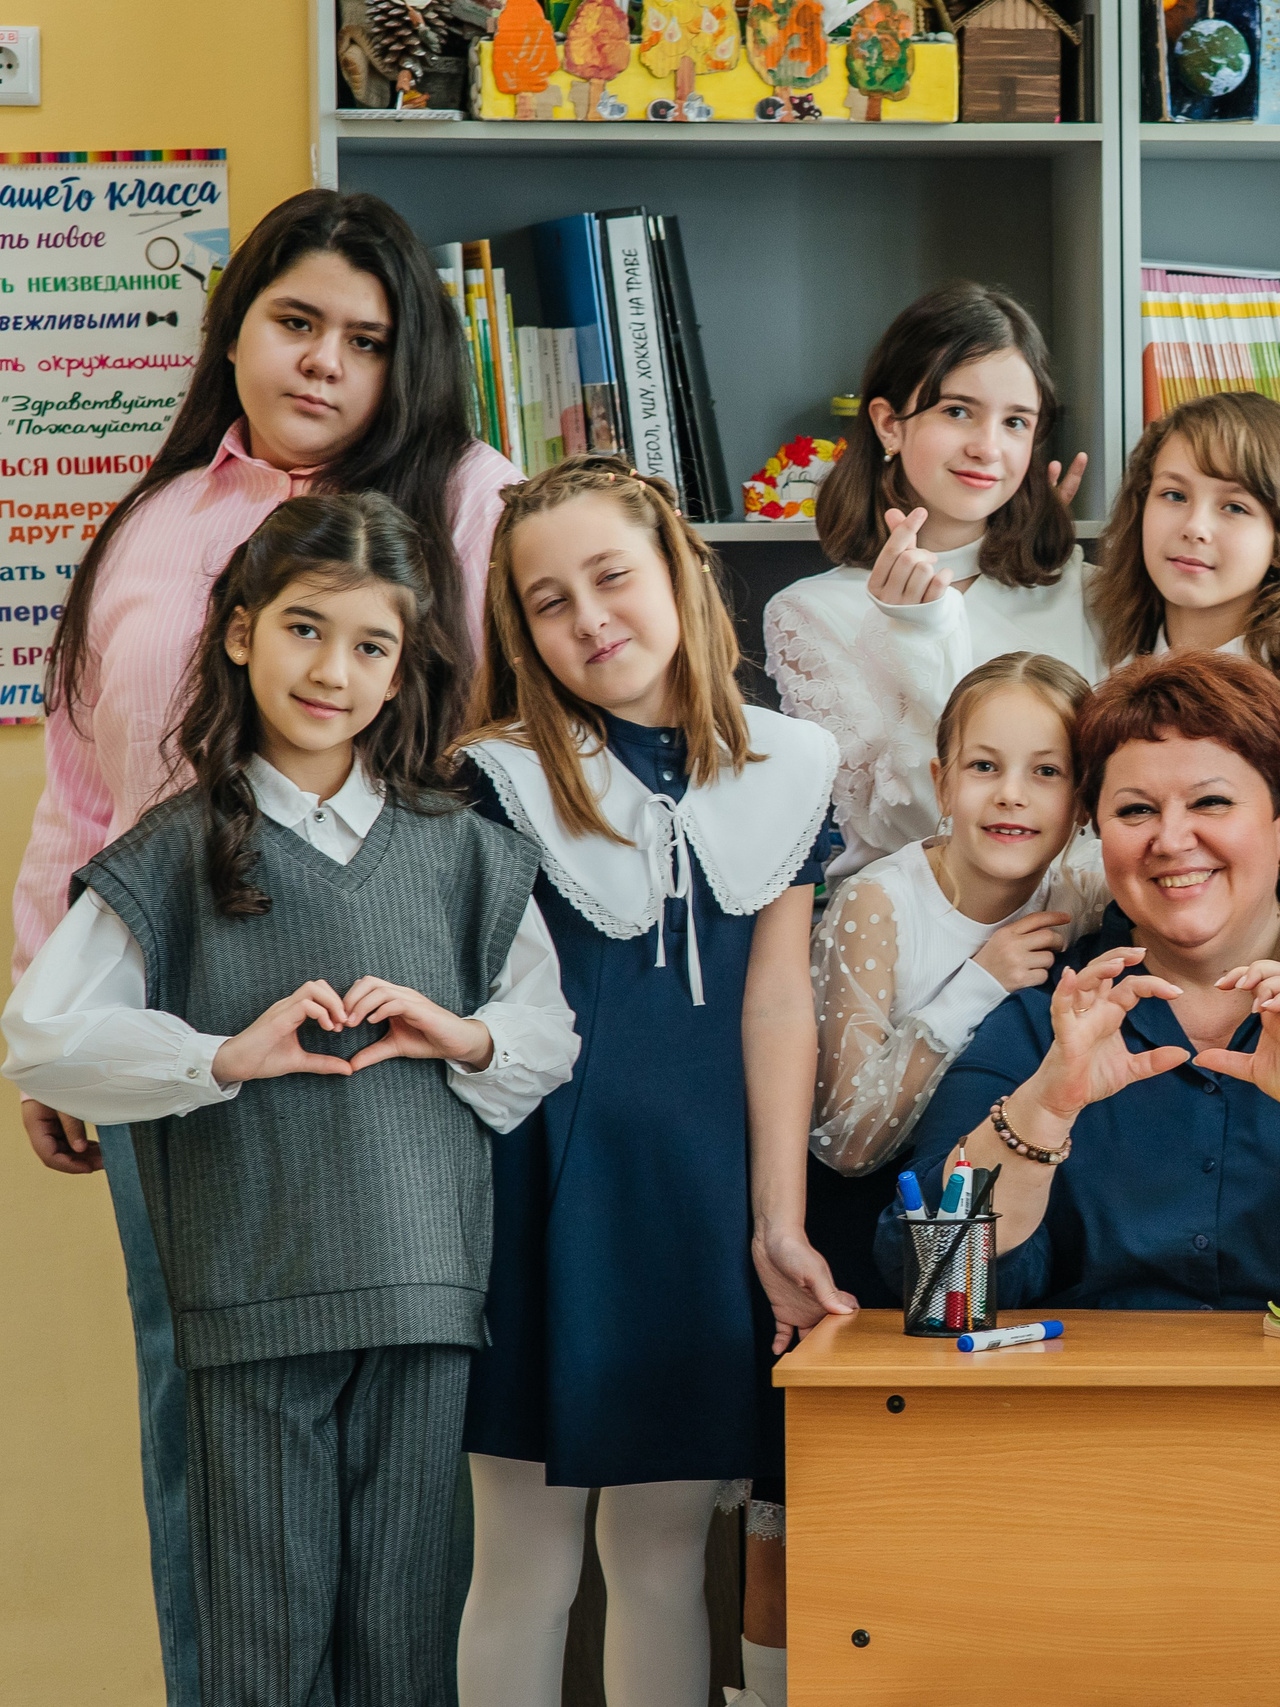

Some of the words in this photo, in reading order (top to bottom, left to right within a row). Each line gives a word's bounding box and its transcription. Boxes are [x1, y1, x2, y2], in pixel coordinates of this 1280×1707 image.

[104, 178, 222, 212] класса
[36, 225, 107, 249] новое
[622, 248, 642, 293] ТРАВЕ
[27, 273, 183, 293] НЕИЗВЕДАННОЕ
[628, 297, 645, 316] НА
[0, 312, 141, 331] ВЕЖЛИВЫМИ
[629, 322, 654, 379] ХОККЕЙ
[37, 354, 197, 378] окружающих
[8, 524, 75, 545] друг
[0, 565, 46, 581] ать
[0, 604, 66, 626] пере
